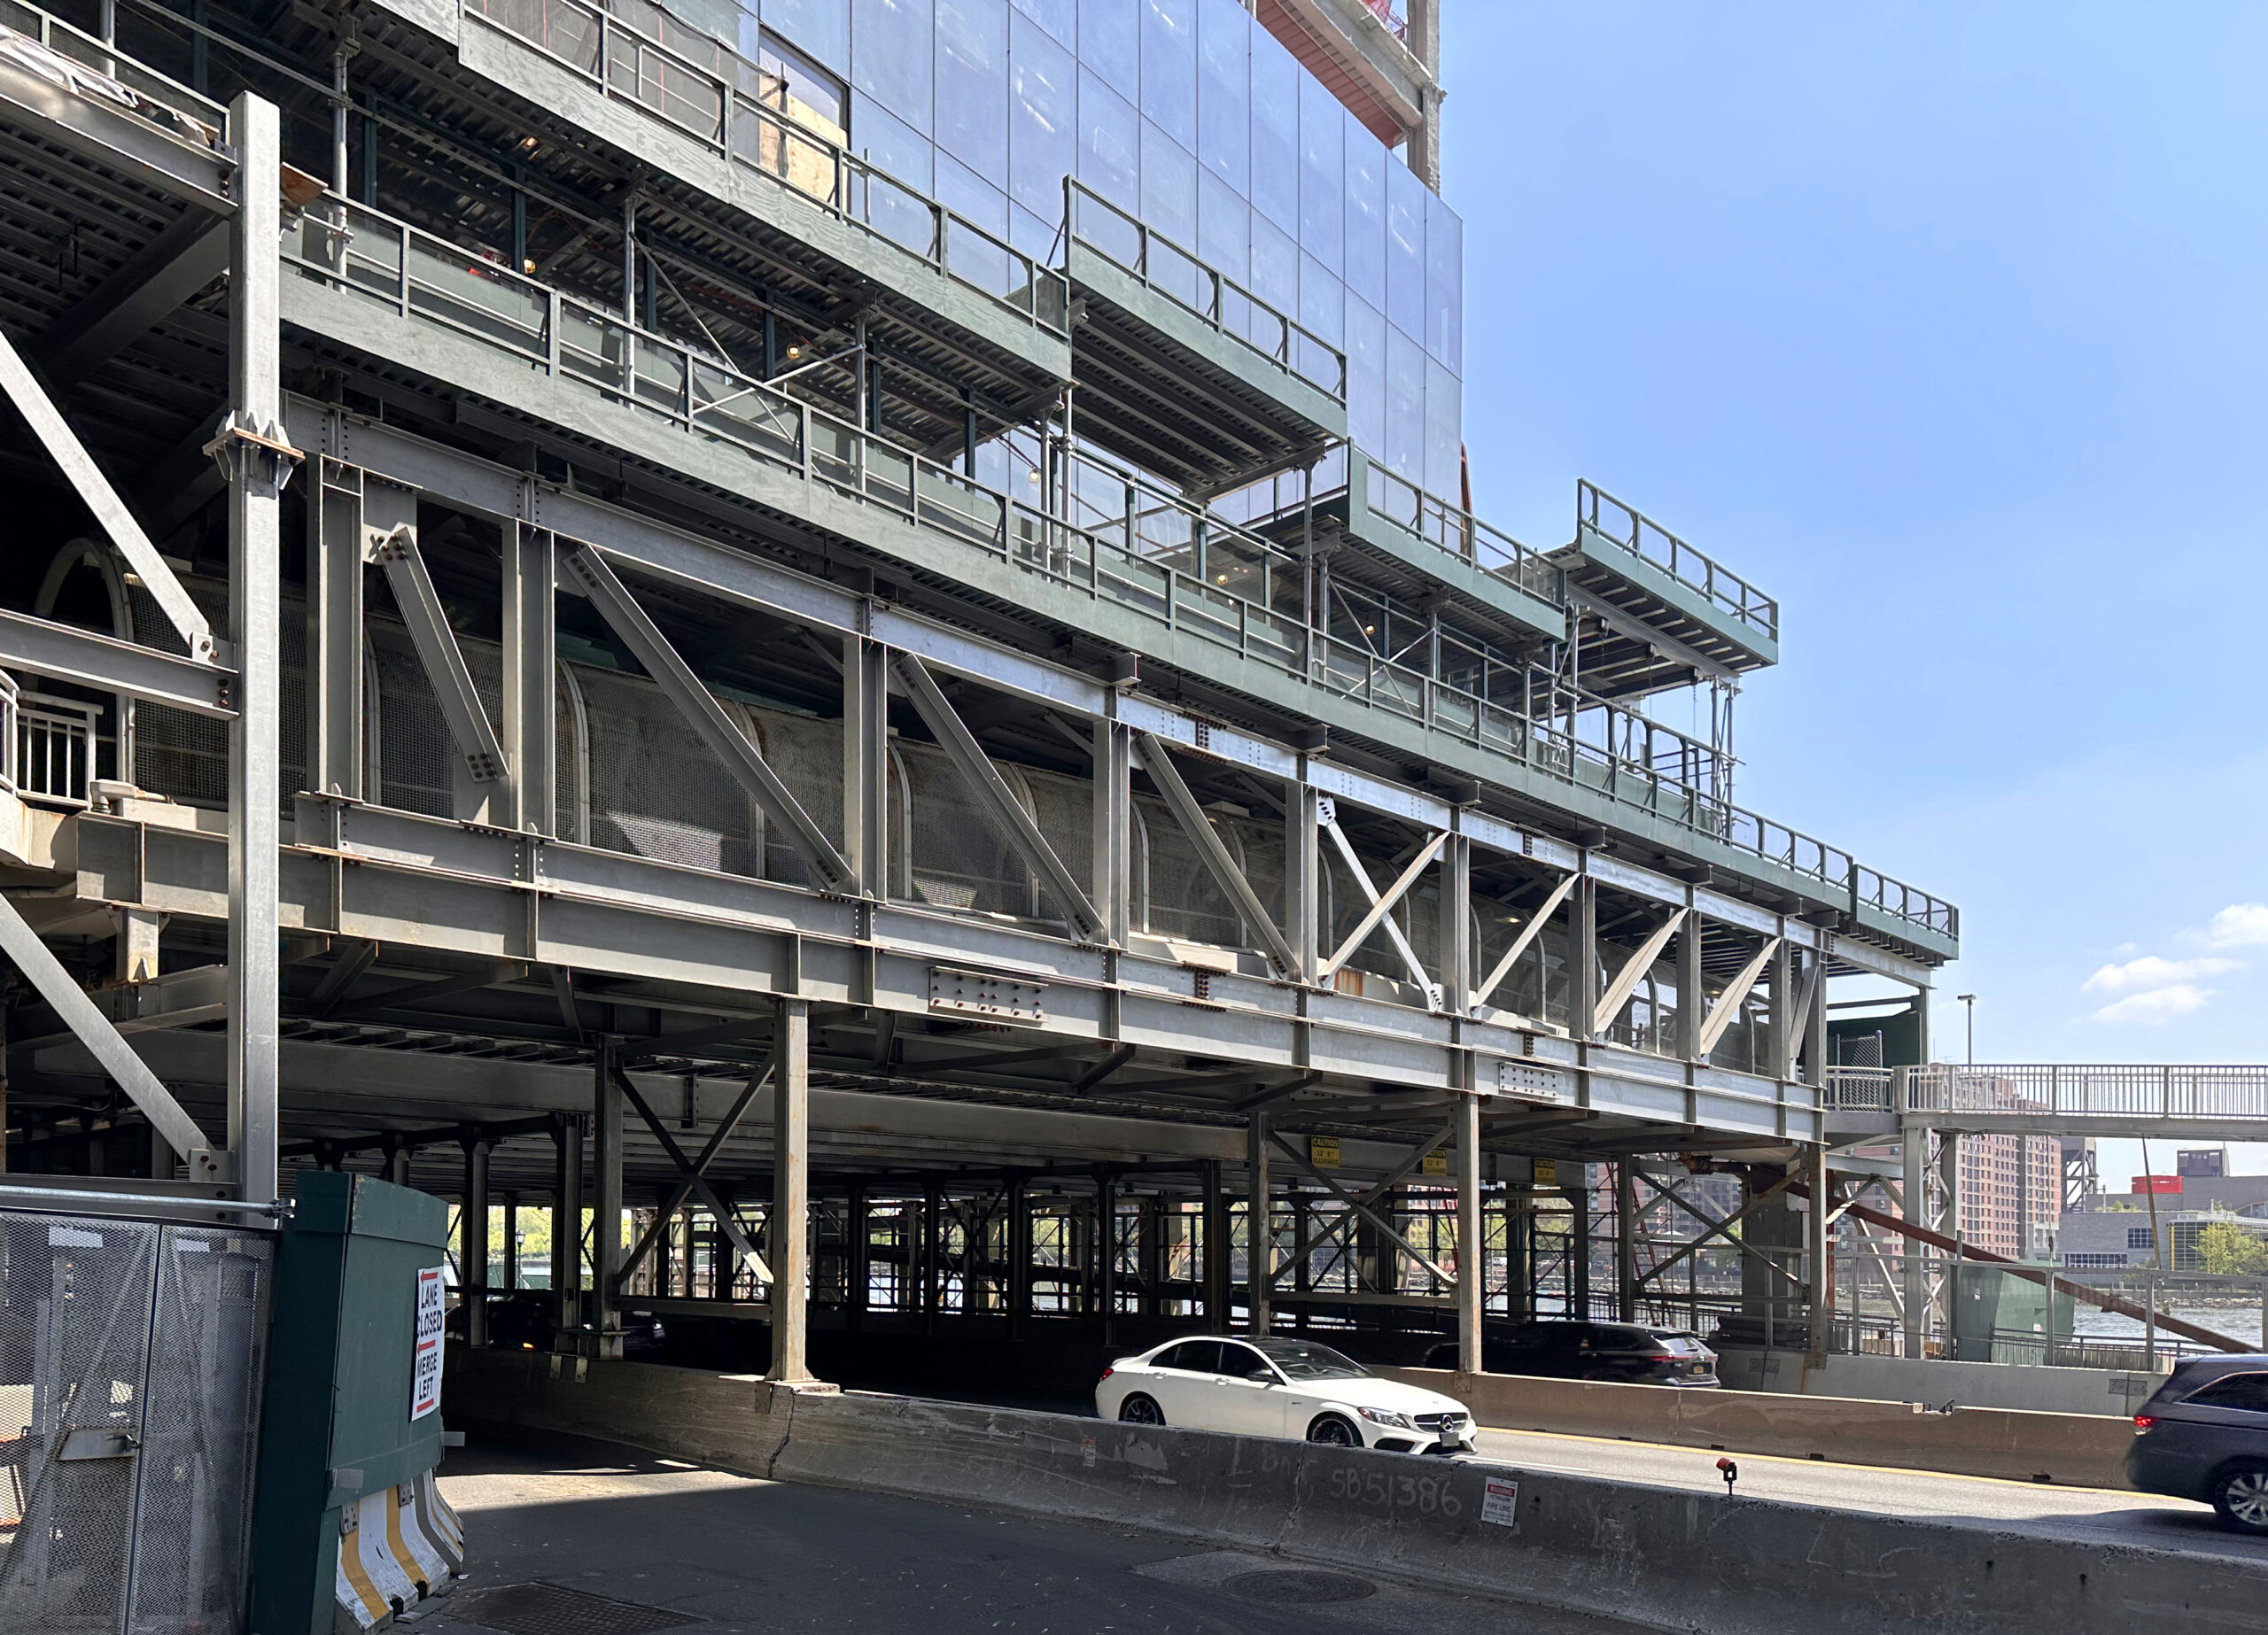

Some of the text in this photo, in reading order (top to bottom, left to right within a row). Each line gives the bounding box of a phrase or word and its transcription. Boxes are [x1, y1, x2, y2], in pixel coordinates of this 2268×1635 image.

[1312, 1136, 1339, 1148] CAUTION
[1313, 1157, 1339, 1166] CLEARANCE
[421, 1283, 438, 1309] LANE
[416, 1309, 443, 1338] CLOSED
[416, 1352, 437, 1378] MERGE
[418, 1375, 434, 1400] LEFT
